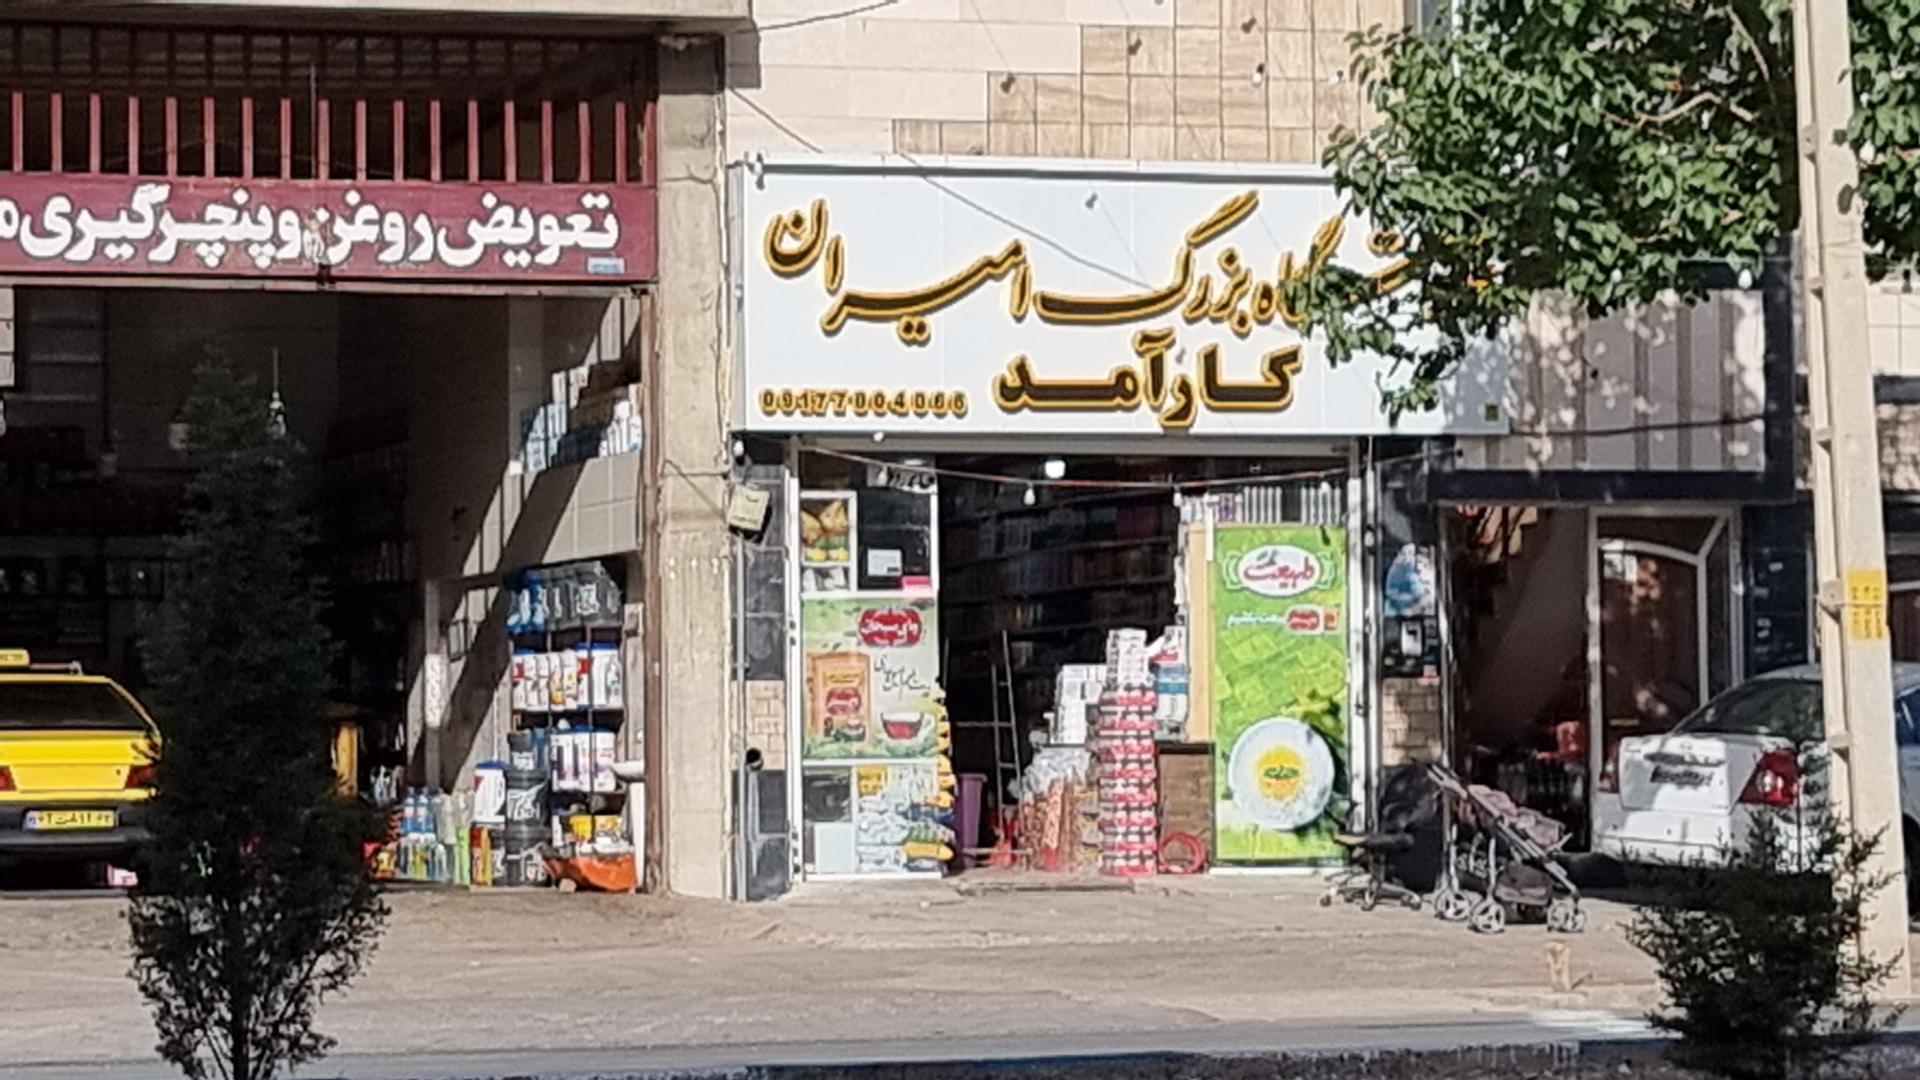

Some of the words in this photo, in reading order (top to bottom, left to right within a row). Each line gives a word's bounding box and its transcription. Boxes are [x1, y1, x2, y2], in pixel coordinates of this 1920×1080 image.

[436, 191, 619, 267] تعویض
[763, 198, 1031, 347] امیران
[1034, 188, 1258, 337] بزرگ
[993, 326, 1304, 429] کارآمد
